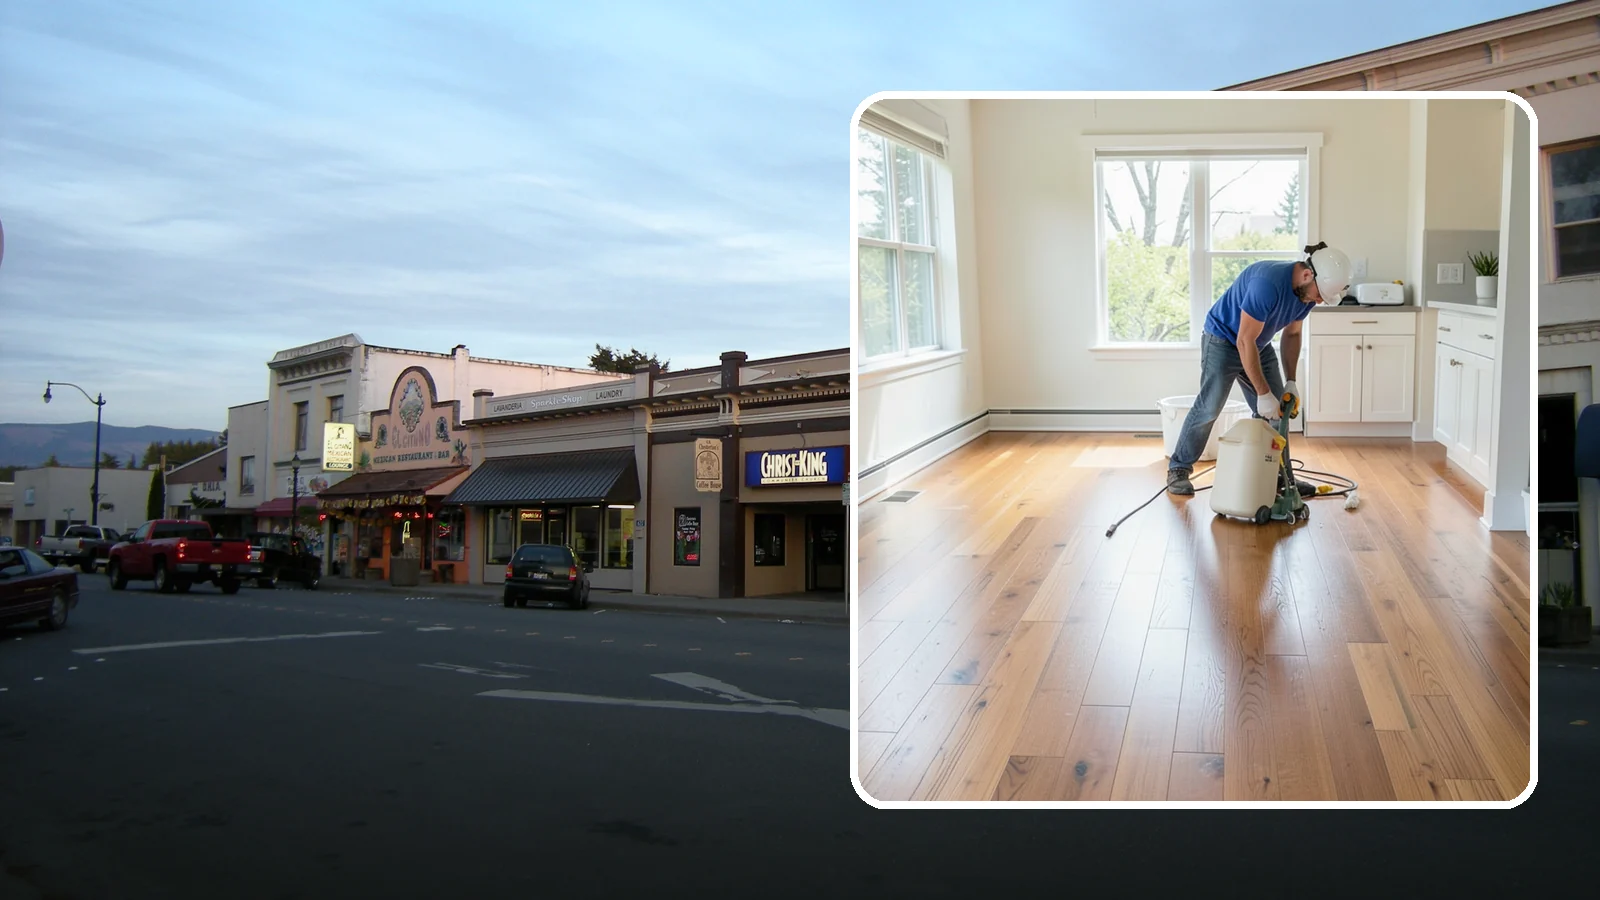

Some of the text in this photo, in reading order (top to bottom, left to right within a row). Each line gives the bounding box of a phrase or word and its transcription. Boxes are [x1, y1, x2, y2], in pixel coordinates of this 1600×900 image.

[494, 402, 522, 412] LAVANDERIA
[561, 395, 582, 404] Shop
[596, 389, 623, 400] LAUNDRY
[374, 455, 396, 464] MEXICAN
[398, 451, 433, 462] RESTAURANT
[438, 450, 450, 459] BAR
[761, 450, 827, 478] CHRIST KING
